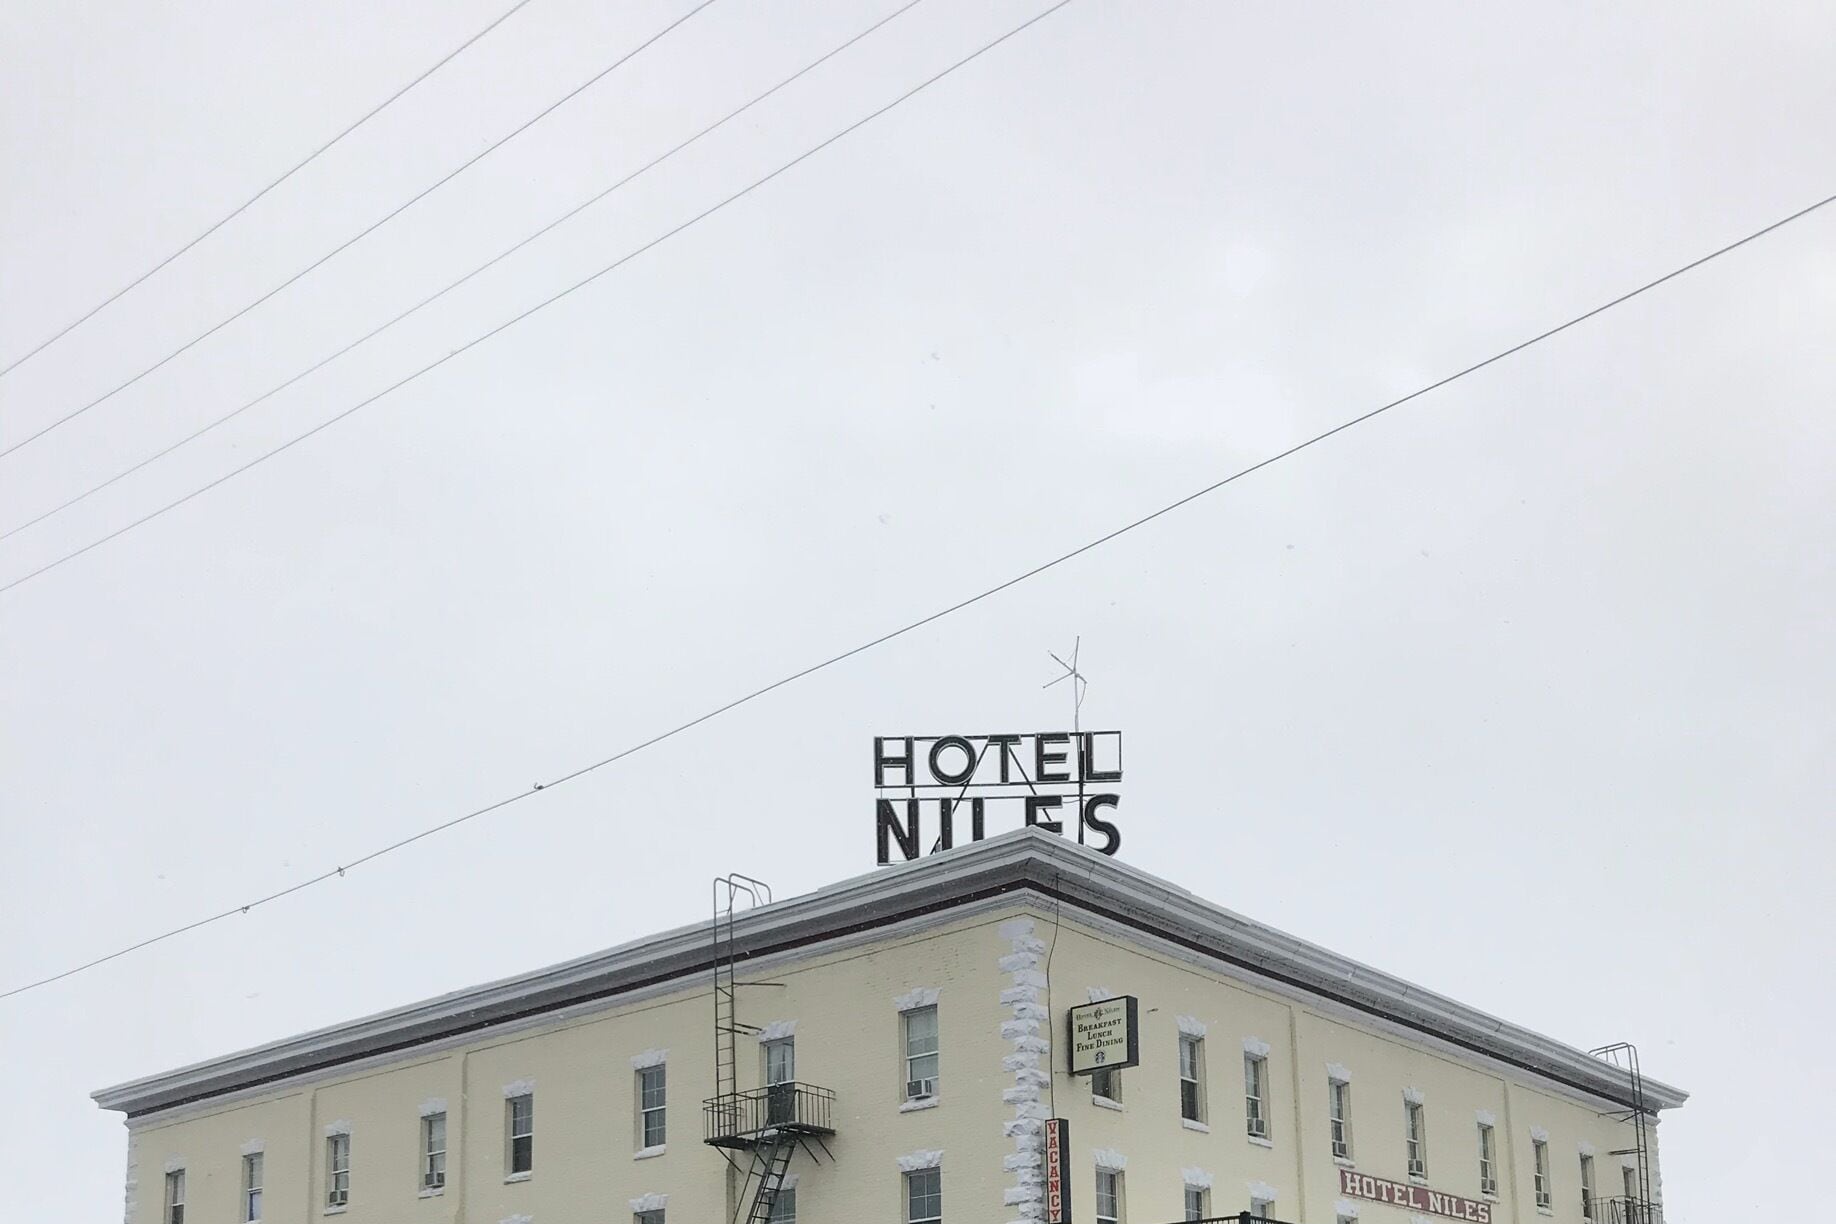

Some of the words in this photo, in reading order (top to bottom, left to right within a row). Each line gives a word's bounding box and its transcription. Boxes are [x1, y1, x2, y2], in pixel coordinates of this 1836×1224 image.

[874, 731, 1123, 786] HOTEL
[1078, 1018, 1121, 1032] BREAKFAST
[1087, 1030, 1112, 1040] LUNCH
[1076, 1043, 1094, 1052] FINE
[1096, 1037, 1123, 1048] DINING
[1048, 1122, 1060, 1221] VACANCY
[1345, 1172, 1422, 1209] HOTEL
[1427, 1191, 1490, 1224] NILES
